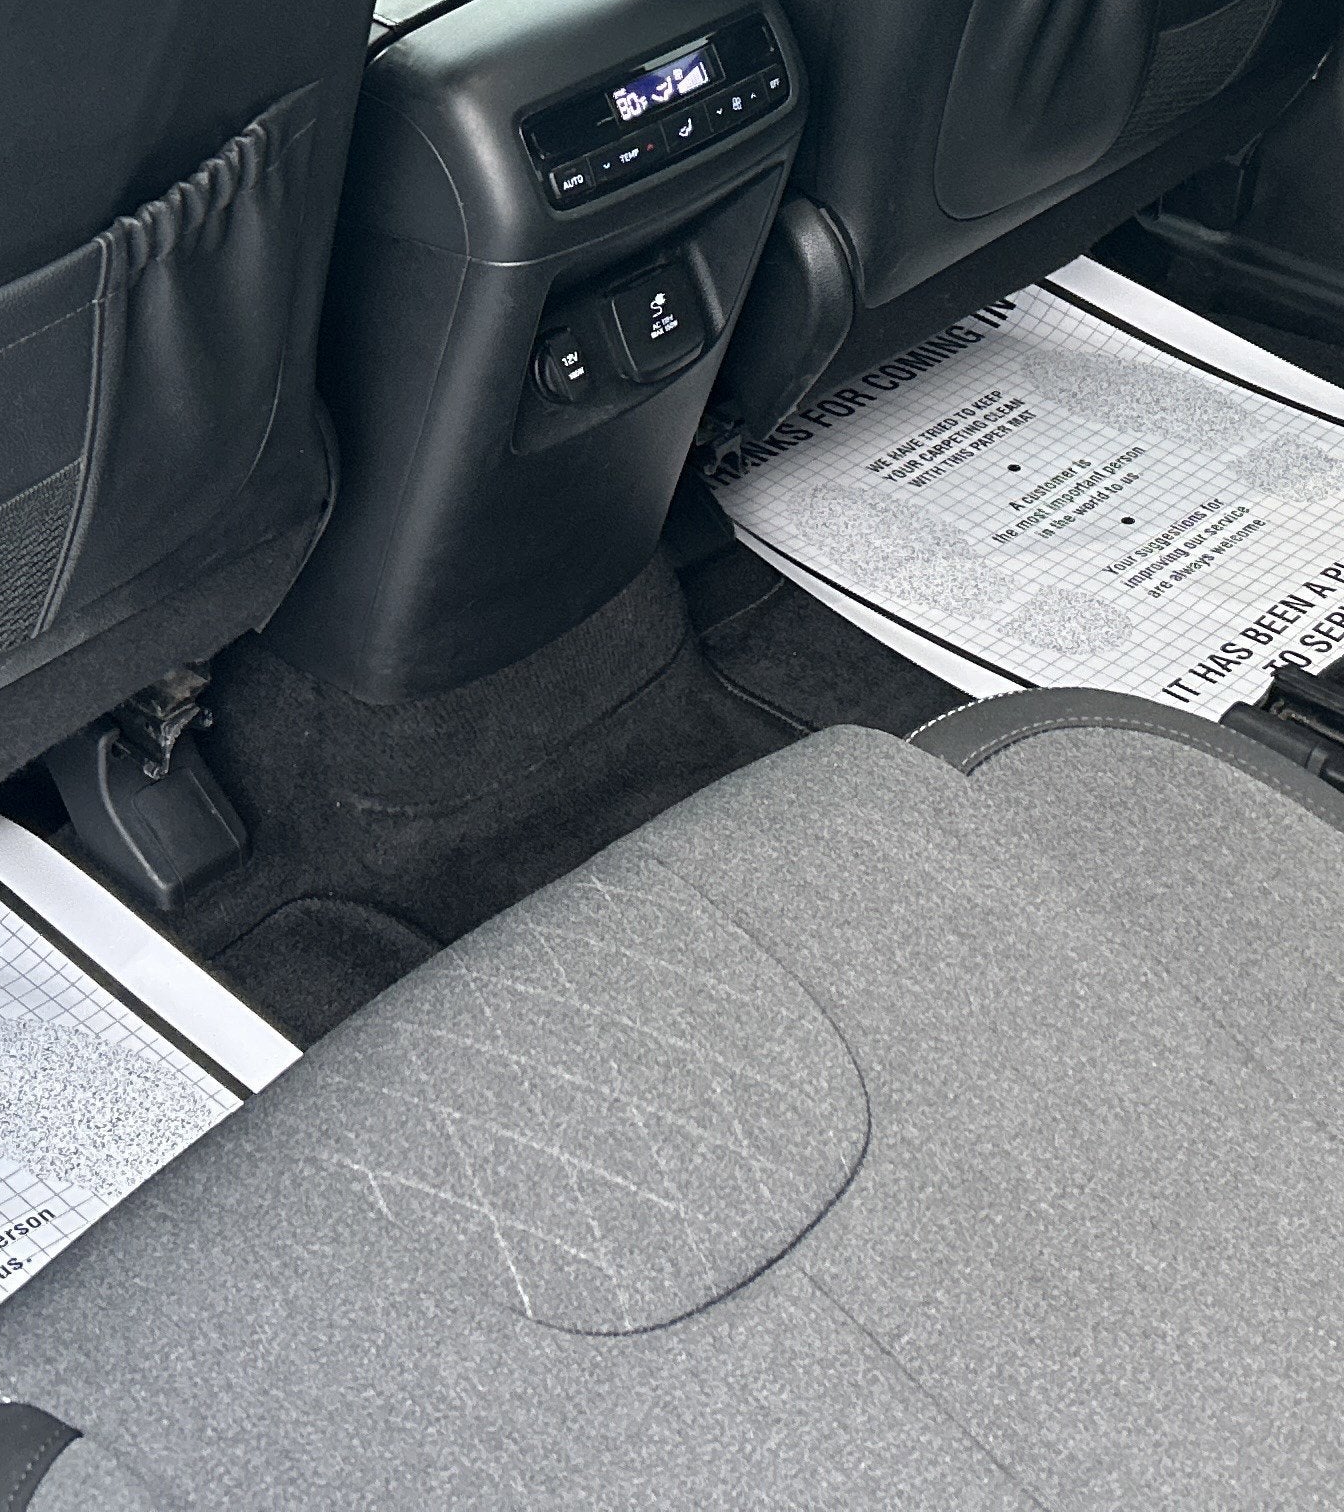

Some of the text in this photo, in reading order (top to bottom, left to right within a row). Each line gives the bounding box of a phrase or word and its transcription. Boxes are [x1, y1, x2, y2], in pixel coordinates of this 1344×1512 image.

[563, 174, 584, 191] AUTO
[619, 148, 640, 164] TEMP
[561, 351, 578, 367] 12V
[799, 388, 877, 429] FOR
[861, 325, 987, 392] COMING
[866, 390, 1003, 473] WE HAVE TRIED TO KEEP
[882, 397, 1026, 483] YOUR CARPETING CLEAN
[907, 409, 1037, 488] WITH THIS PAPER MAT
[992, 446, 1146, 545] the most important person
[1008, 458, 1092, 512] A customer is
[1034, 527, 1056, 539] in
[1050, 513, 1076, 530] the
[1072, 490, 1110, 516] world
[1104, 483, 1124, 494] to
[1102, 498, 1225, 576] Your suggestions for
[1120, 505, 1250, 590] improving our service
[1147, 579, 1174, 599] are
[1169, 553, 1215, 582] always
[1162, 677, 1201, 703] IT
[1188, 642, 1254, 684] HAS
[1239, 593, 1316, 646] BEEN
[1302, 581, 1337, 599] A
